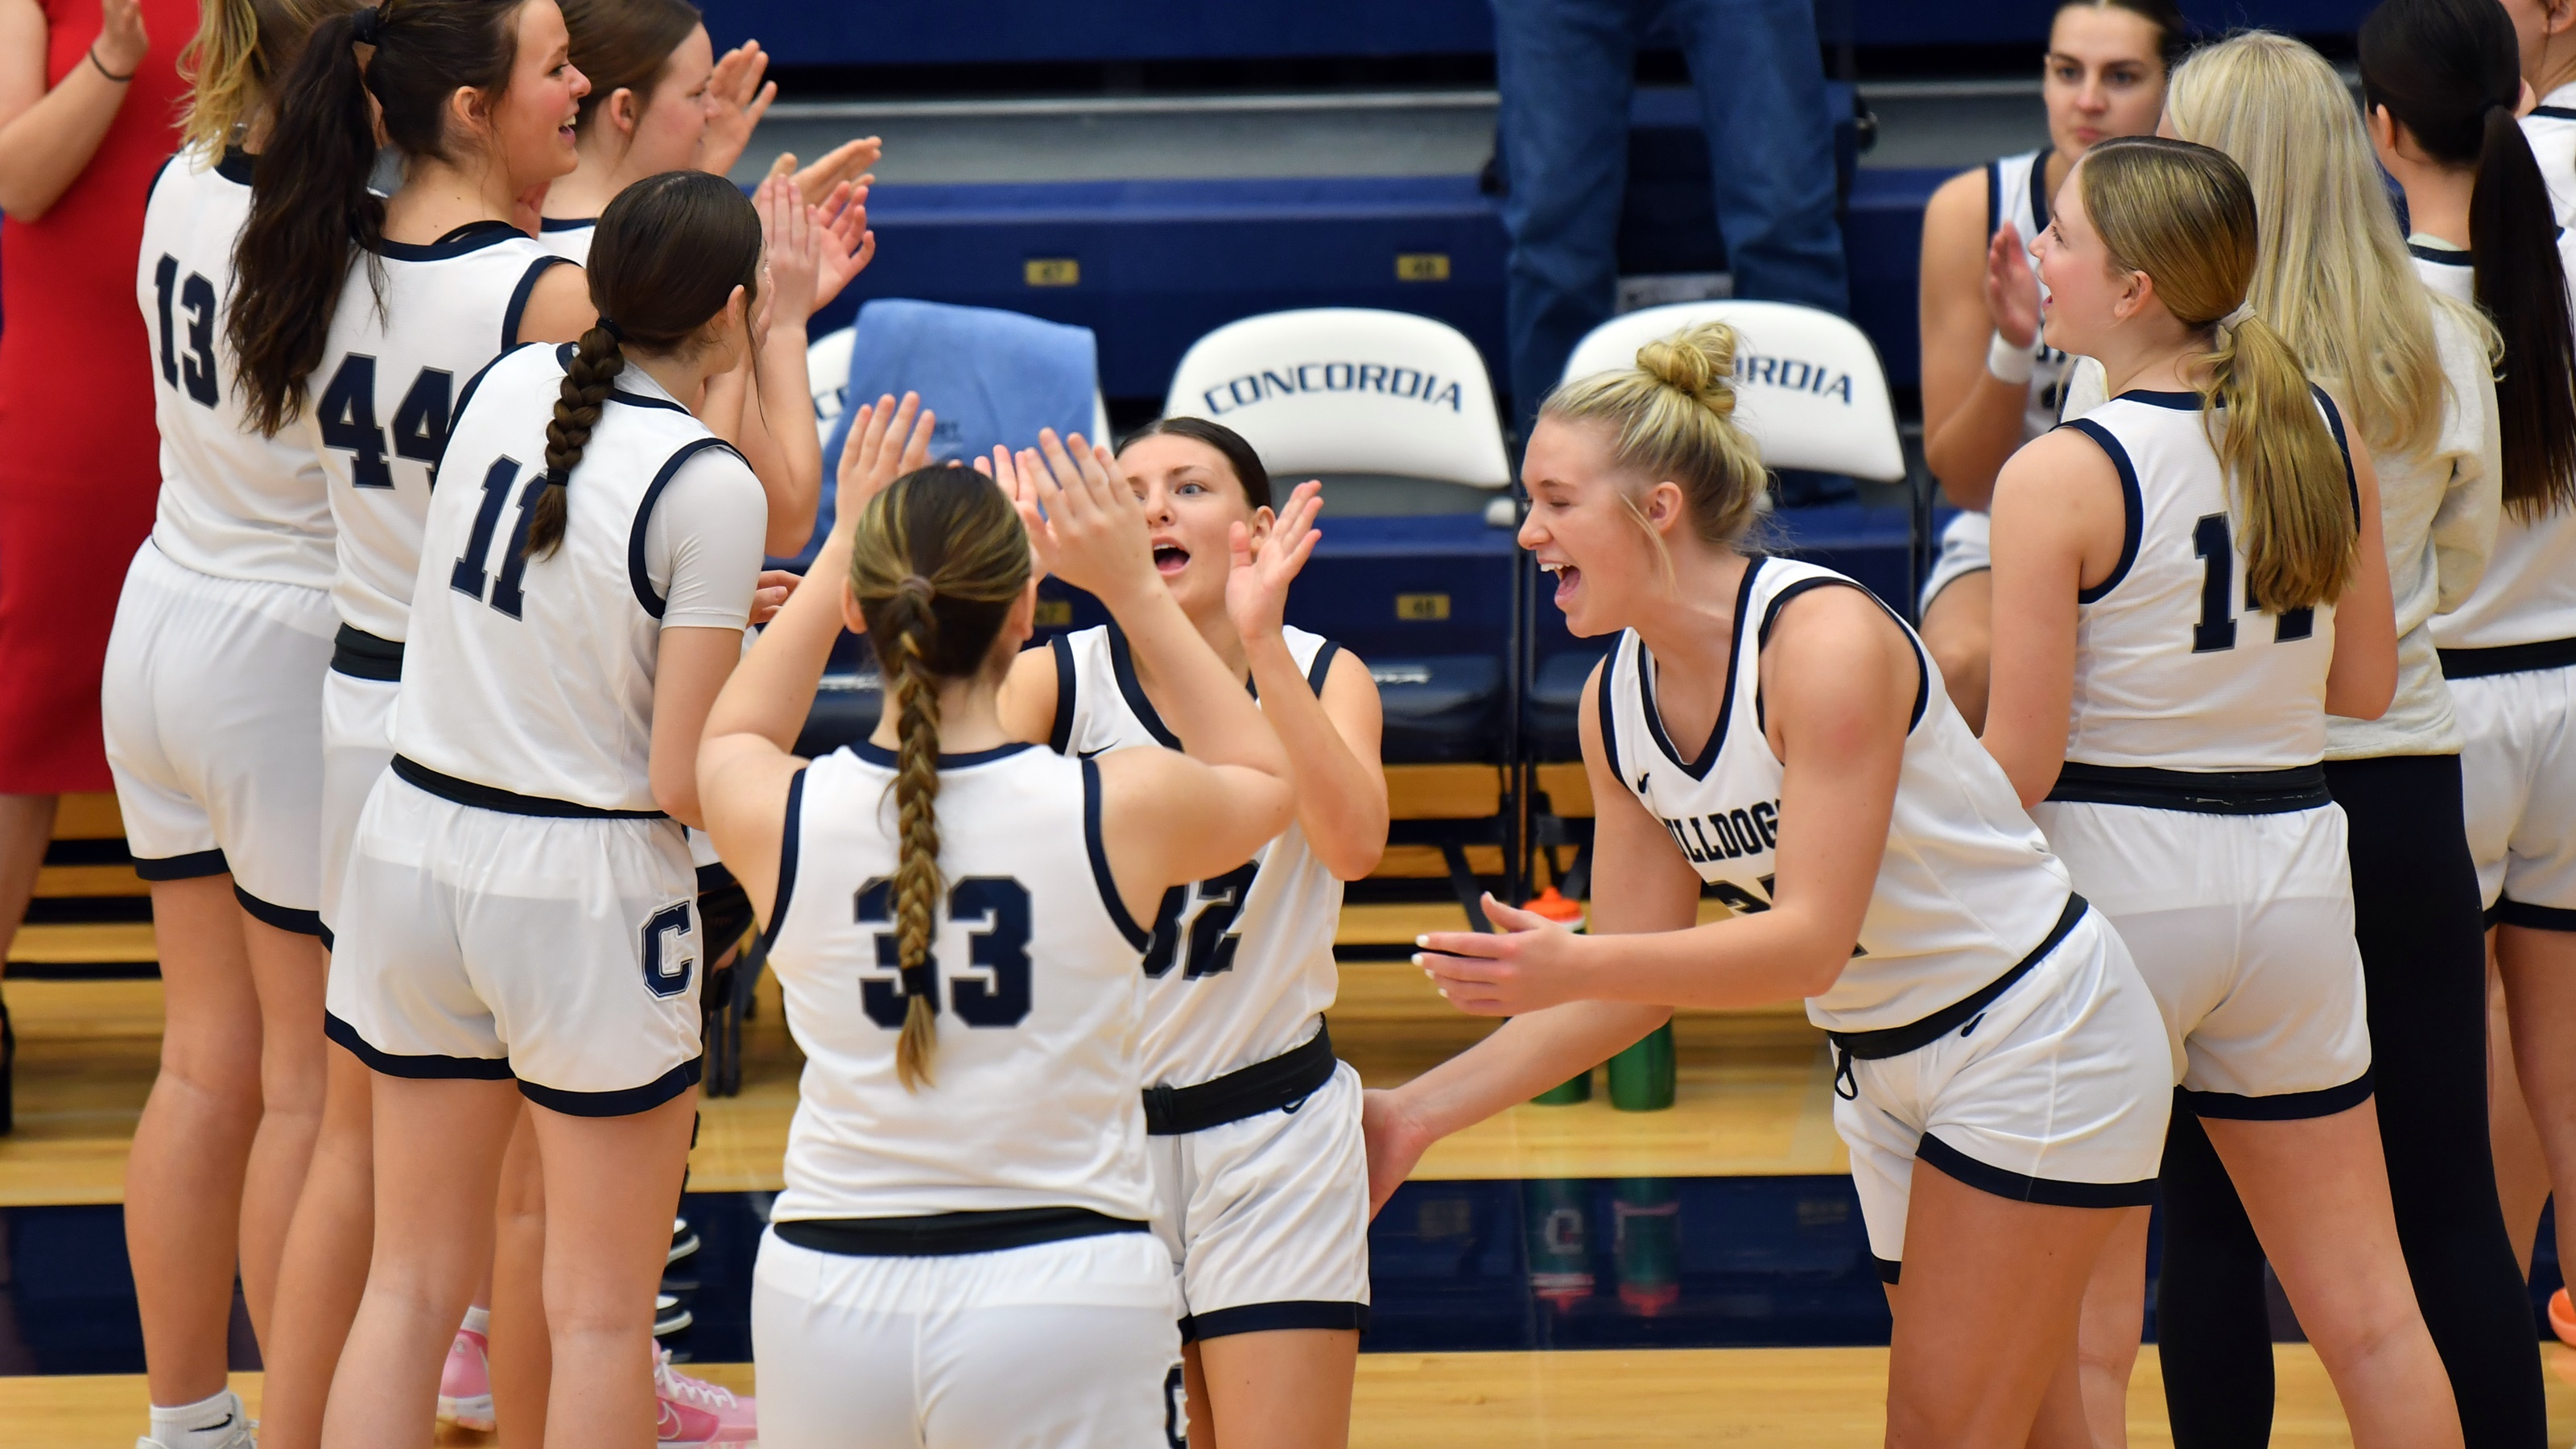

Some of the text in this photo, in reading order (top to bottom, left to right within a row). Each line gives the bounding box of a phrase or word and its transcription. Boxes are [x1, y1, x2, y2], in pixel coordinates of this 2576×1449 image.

[155, 253, 220, 411] 13
[1203, 361, 1462, 414] CONCORDIA
[316, 352, 453, 496] 44
[449, 453, 548, 621] 11
[642, 899, 693, 998] C
[854, 876, 1033, 1030] 33
